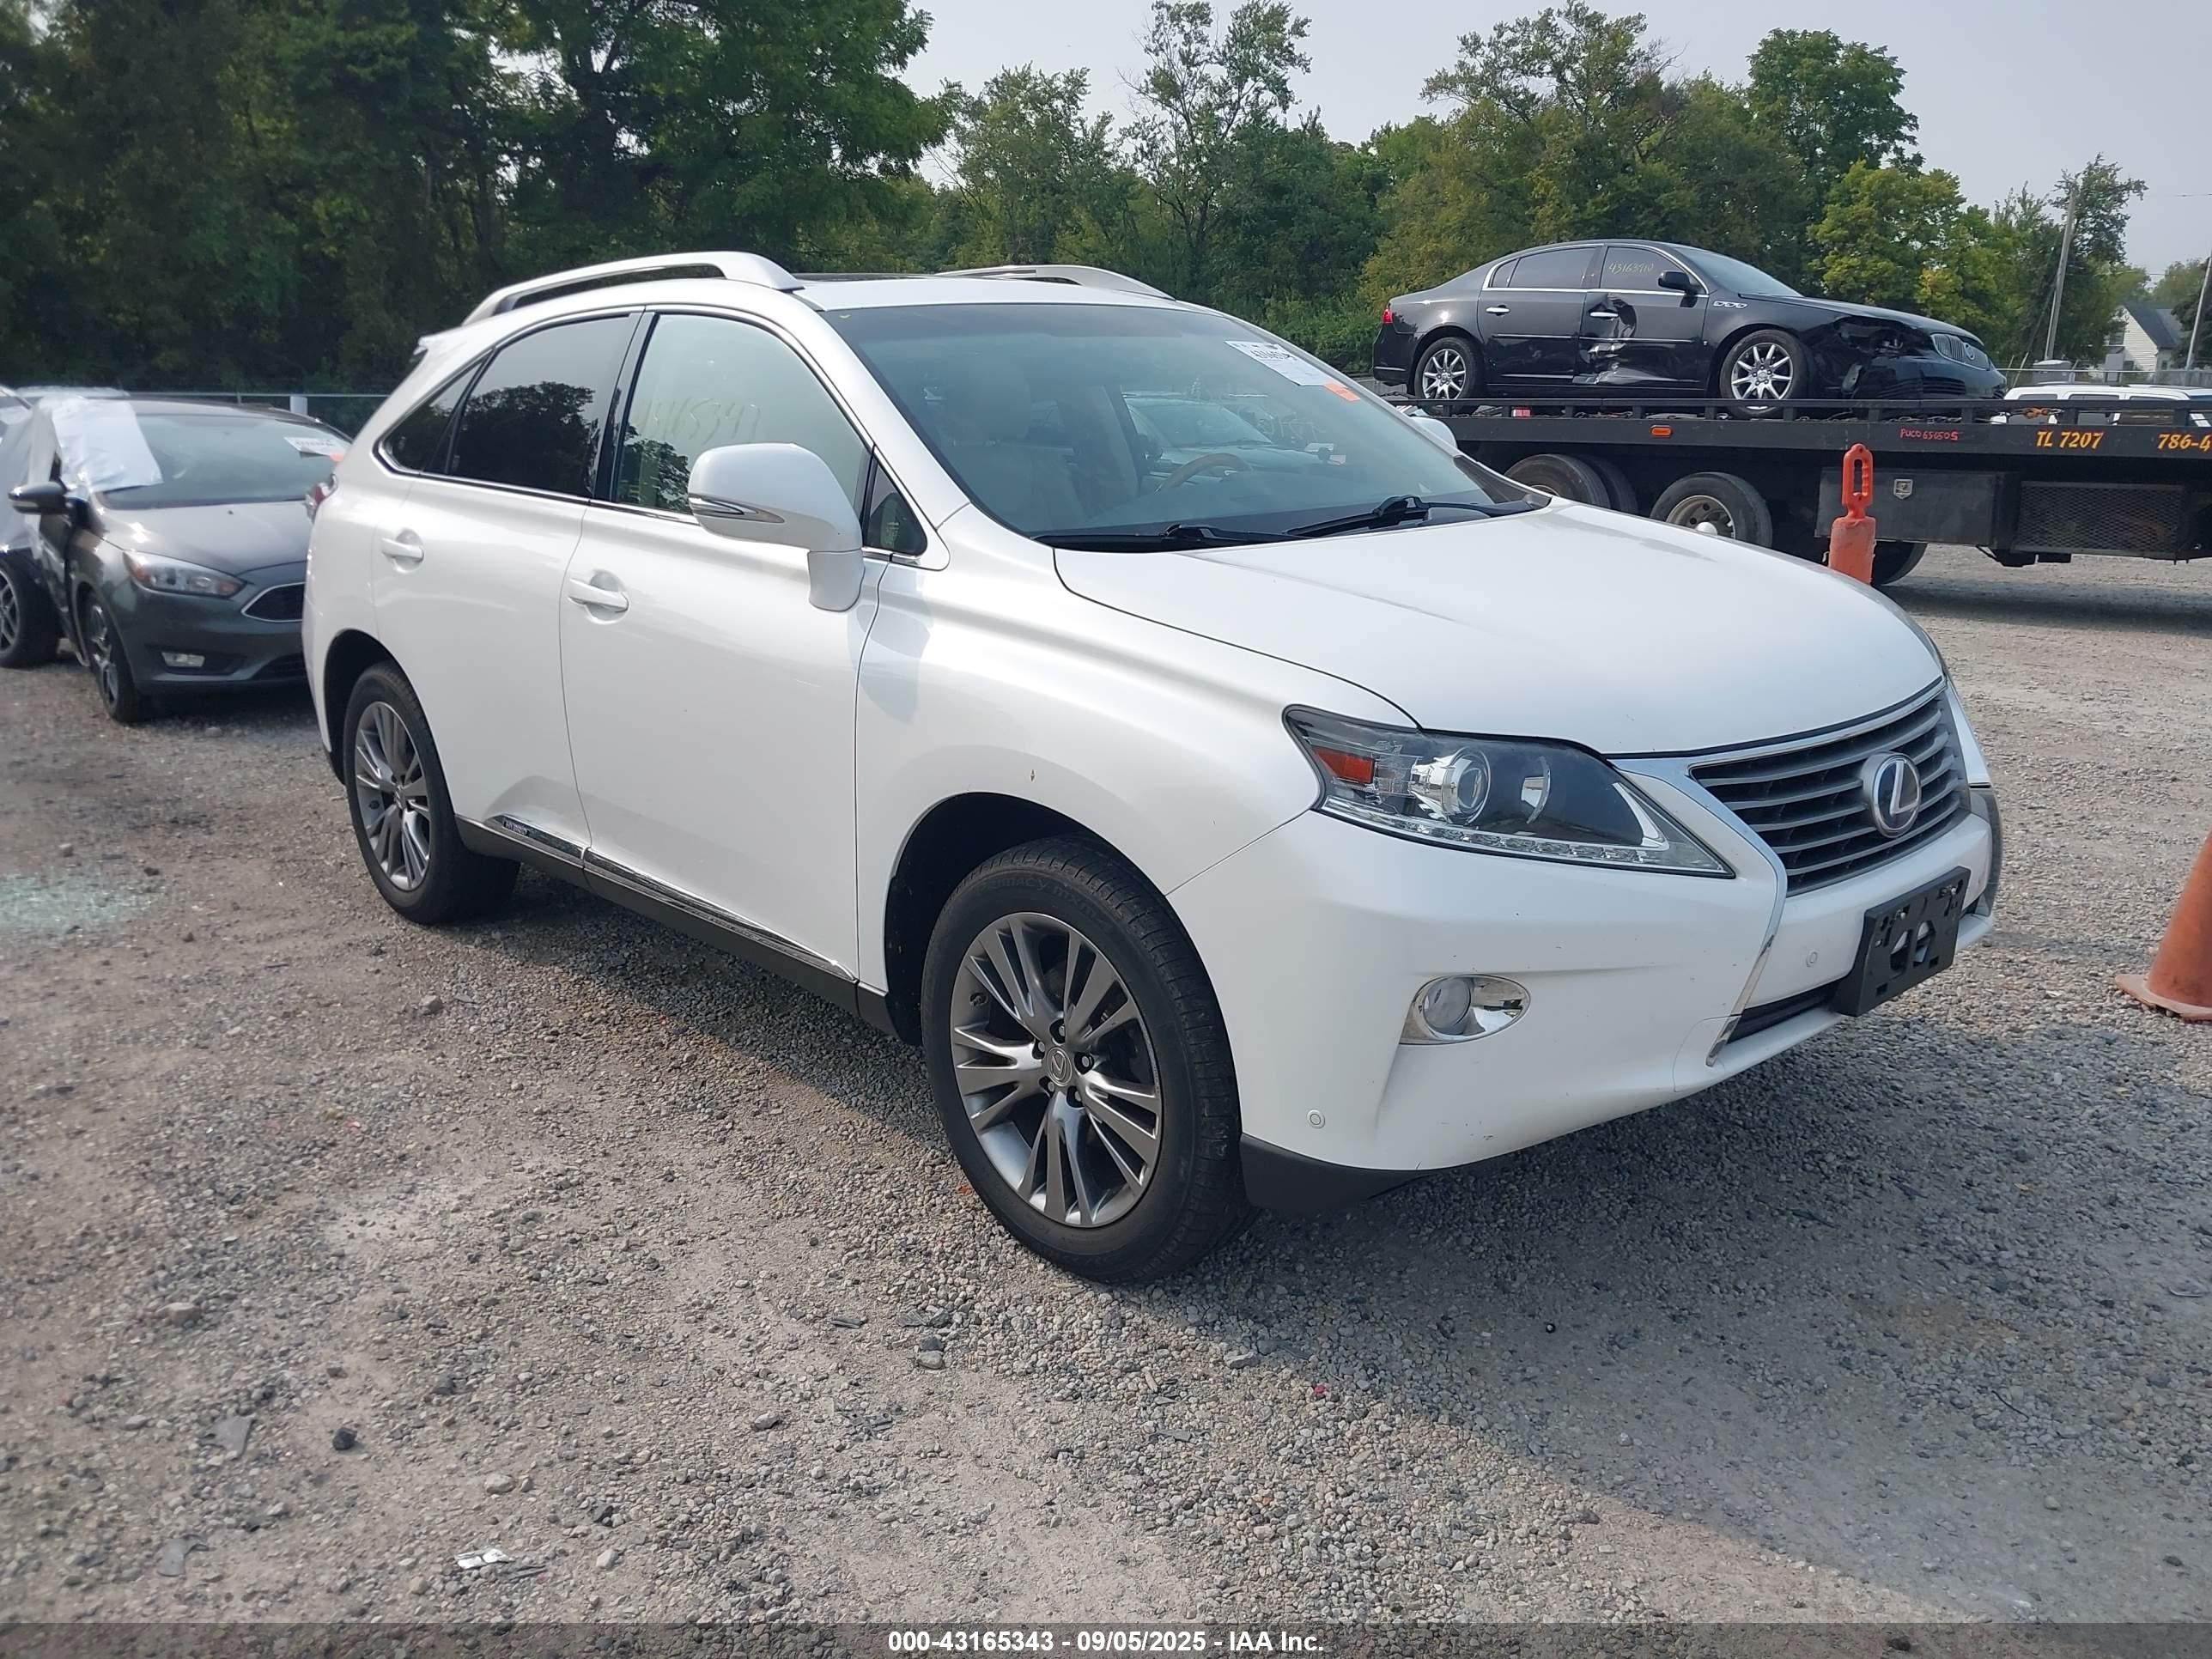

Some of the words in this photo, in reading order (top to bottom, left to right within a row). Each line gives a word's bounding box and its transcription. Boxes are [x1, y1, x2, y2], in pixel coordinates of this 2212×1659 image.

[2036, 430, 2054, 447] TL
[2059, 431, 2104, 449] 7207
[2156, 433, 2212, 452] 786-4
